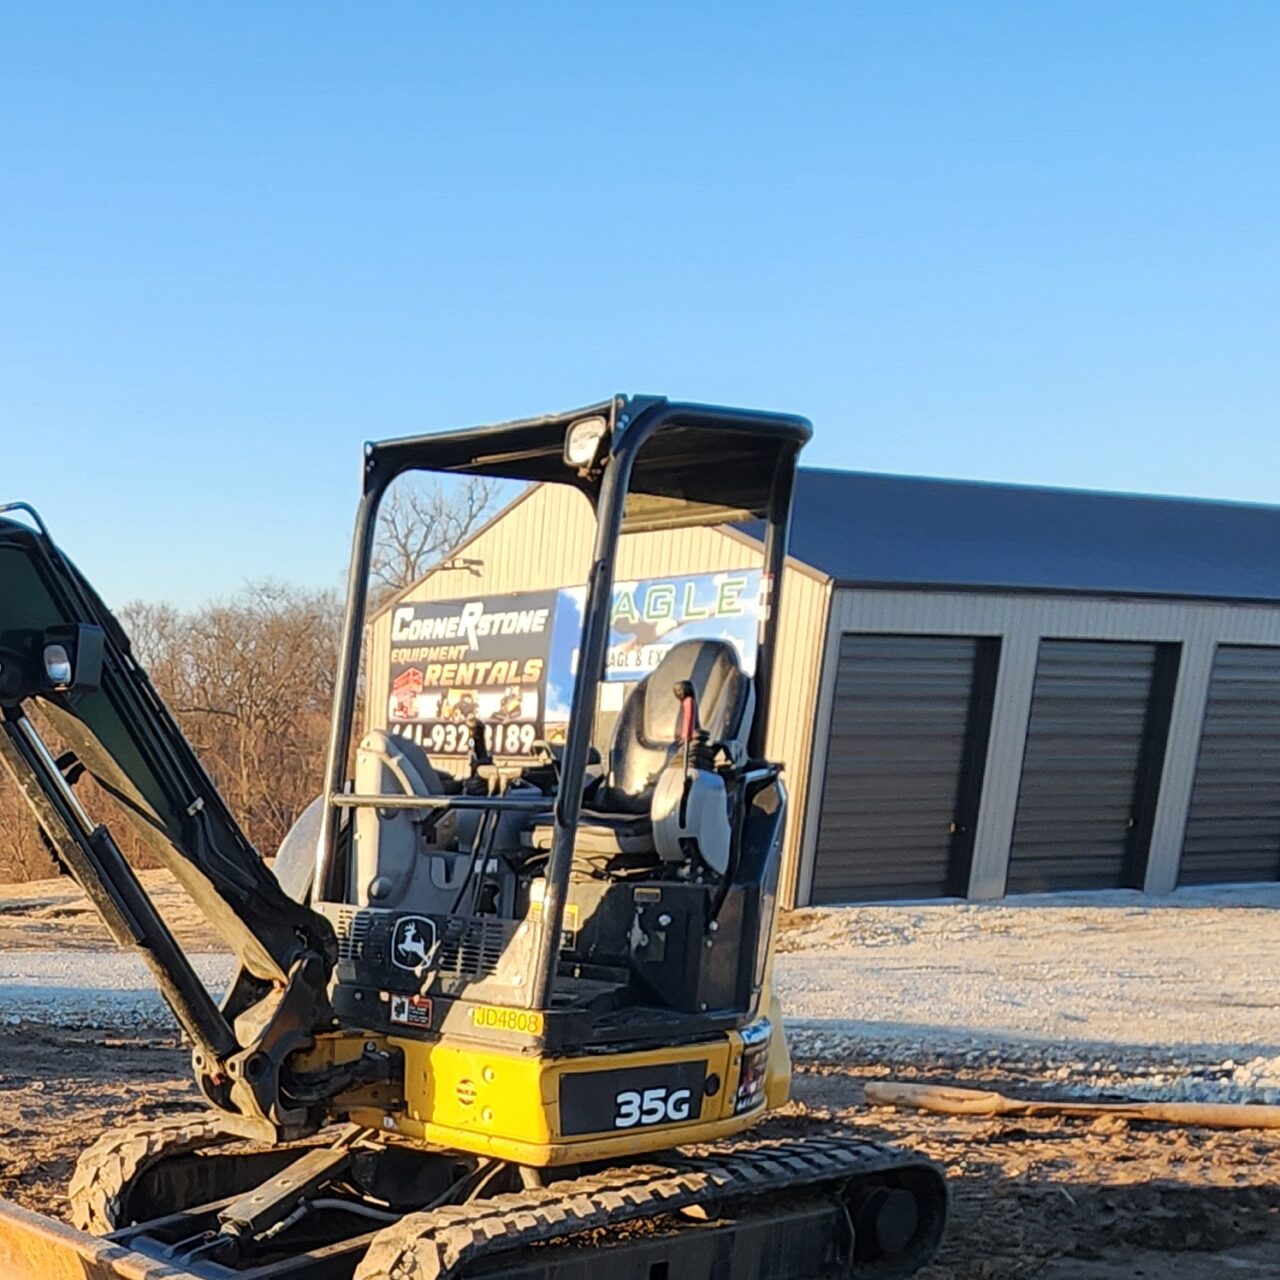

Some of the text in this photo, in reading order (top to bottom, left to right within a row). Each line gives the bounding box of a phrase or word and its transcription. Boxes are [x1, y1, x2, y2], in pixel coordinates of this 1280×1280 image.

[611, 576, 748, 625] AGLE
[391, 645, 469, 665] EQUIPMENT
[424, 658, 544, 687] RENTALS
[476, 1006, 540, 1032] JD4808
[614, 1088, 691, 1127] 35G
